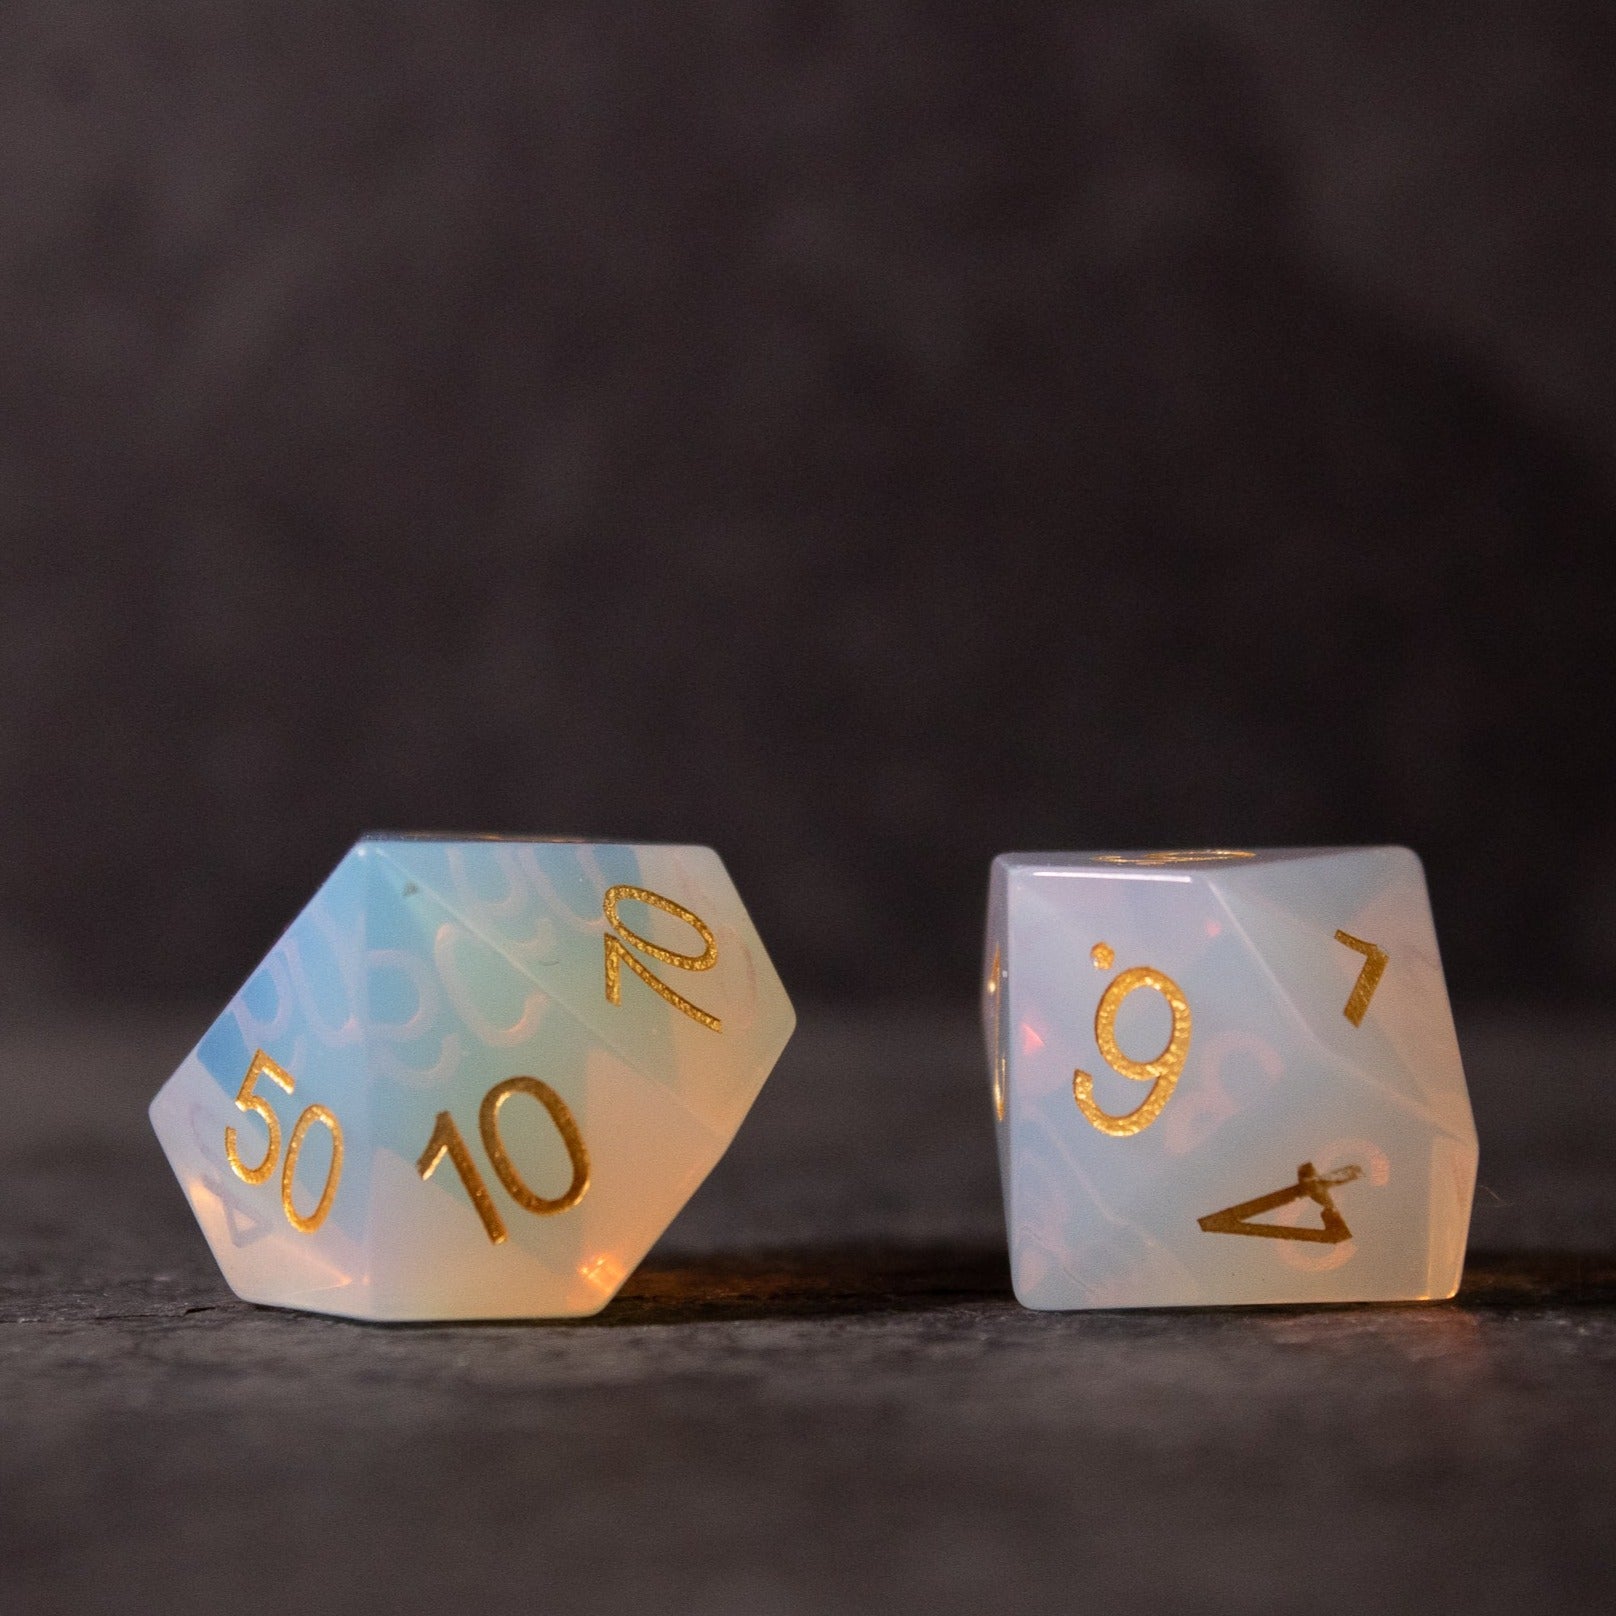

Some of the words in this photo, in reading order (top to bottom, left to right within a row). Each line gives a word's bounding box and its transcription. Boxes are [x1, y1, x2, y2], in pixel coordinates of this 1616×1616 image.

[225, 1049, 343, 1234] 50
[417, 1076, 591, 1245] 10
[1197, 1161, 1364, 1245] 4
